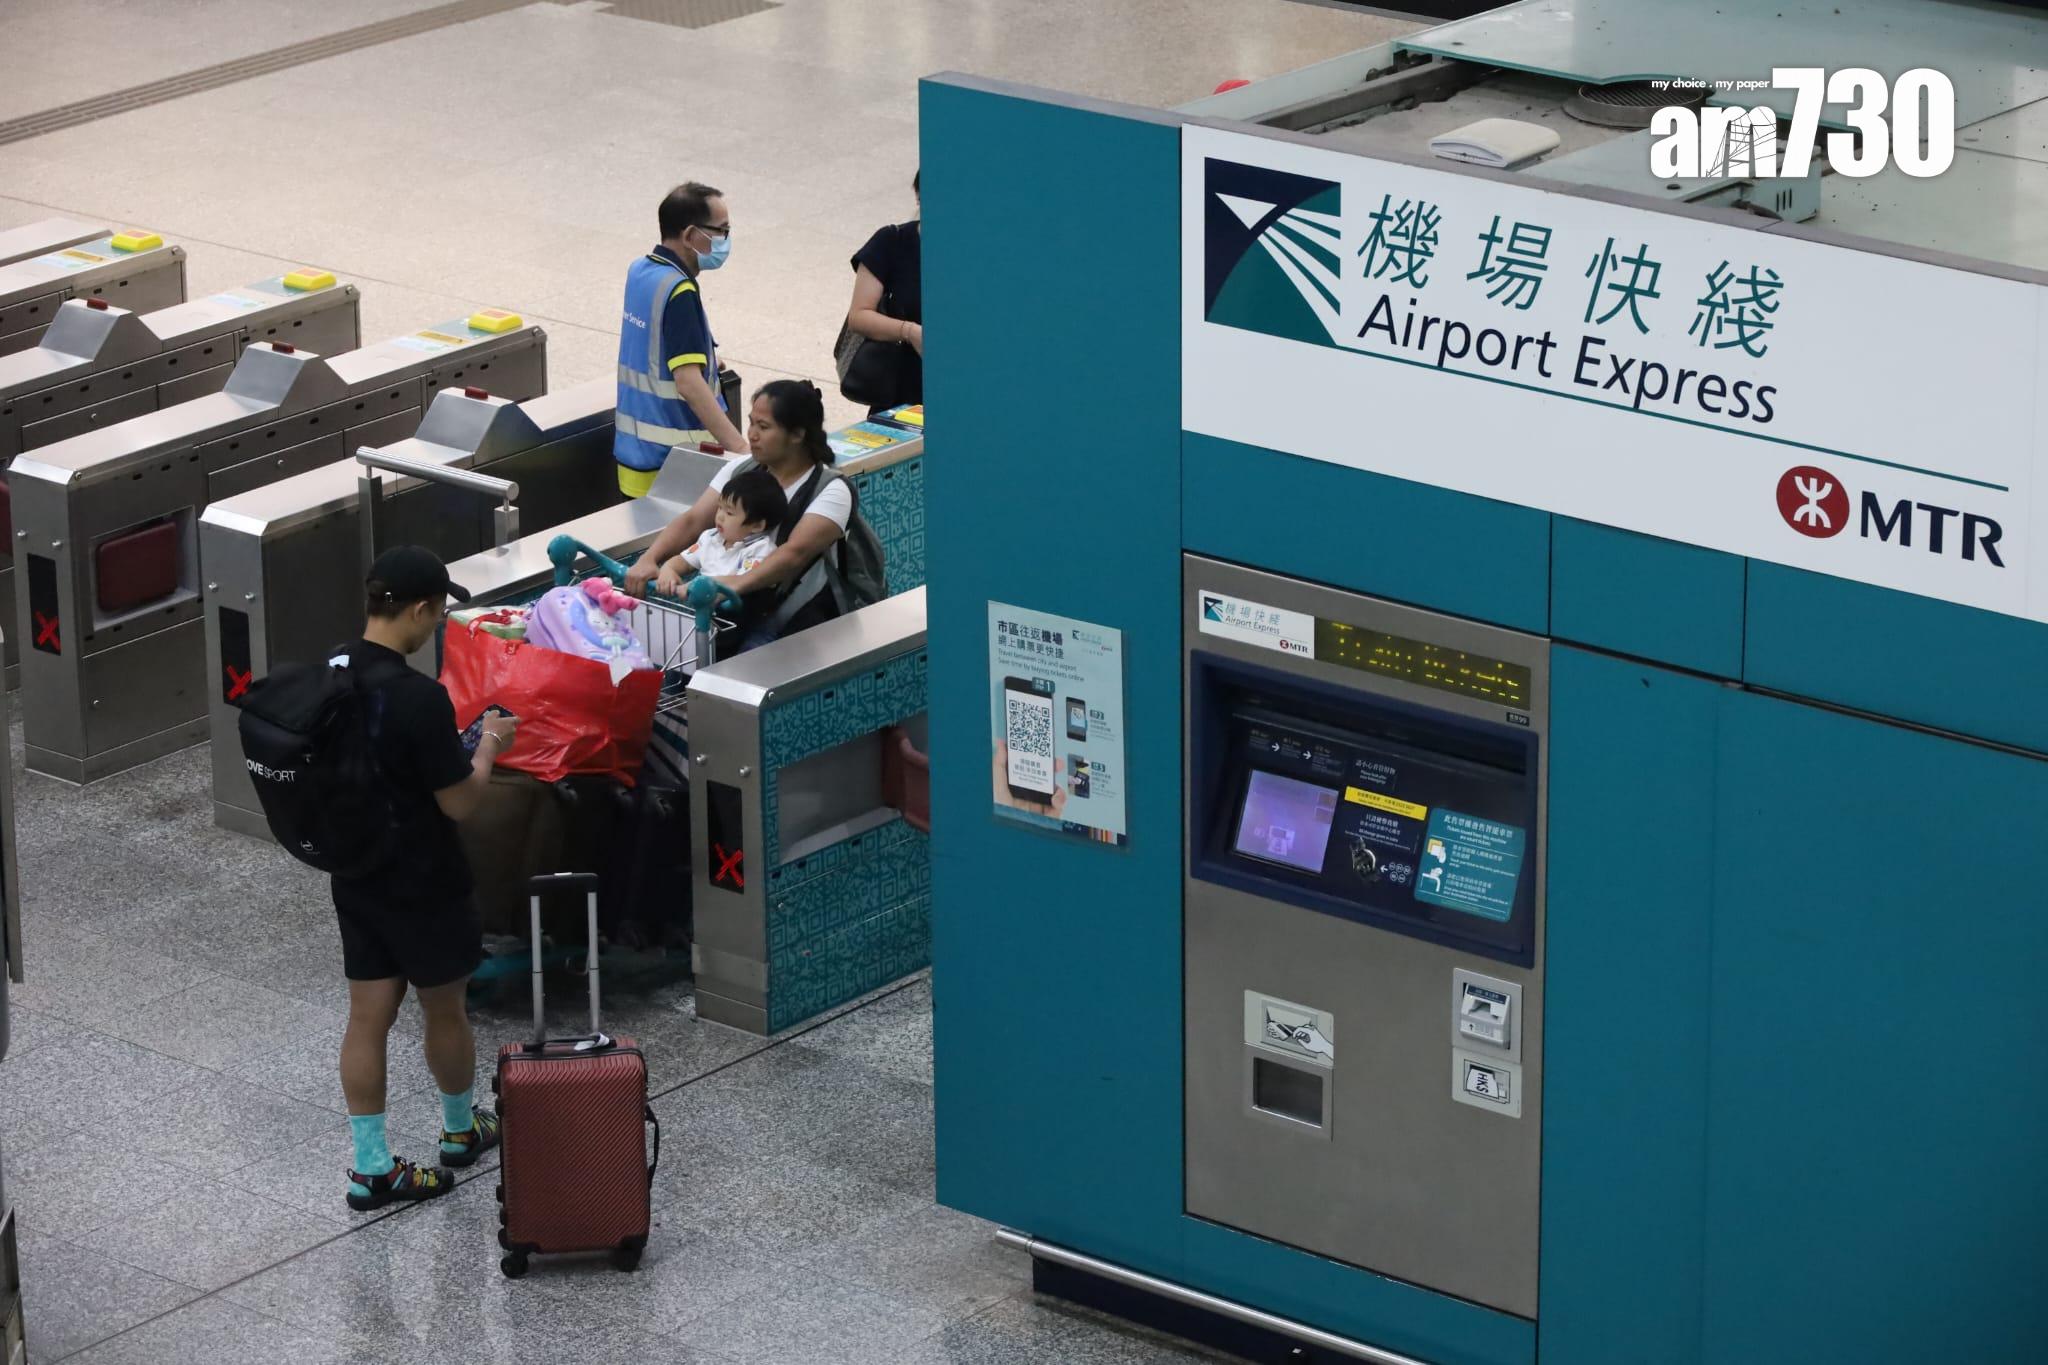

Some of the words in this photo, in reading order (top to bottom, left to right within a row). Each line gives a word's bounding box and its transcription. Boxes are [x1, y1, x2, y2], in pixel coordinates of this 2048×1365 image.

[1357, 193, 1785, 359] 機場快綫
[1357, 294, 1558, 378] Airport
[1573, 335, 1778, 424] Express
[1860, 490, 2006, 568] MTR
[1225, 616, 1252, 628] Airport
[1253, 622, 1280, 635] Express
[1289, 643, 1308, 654] MTR
[264, 766, 296, 782] SPORT
